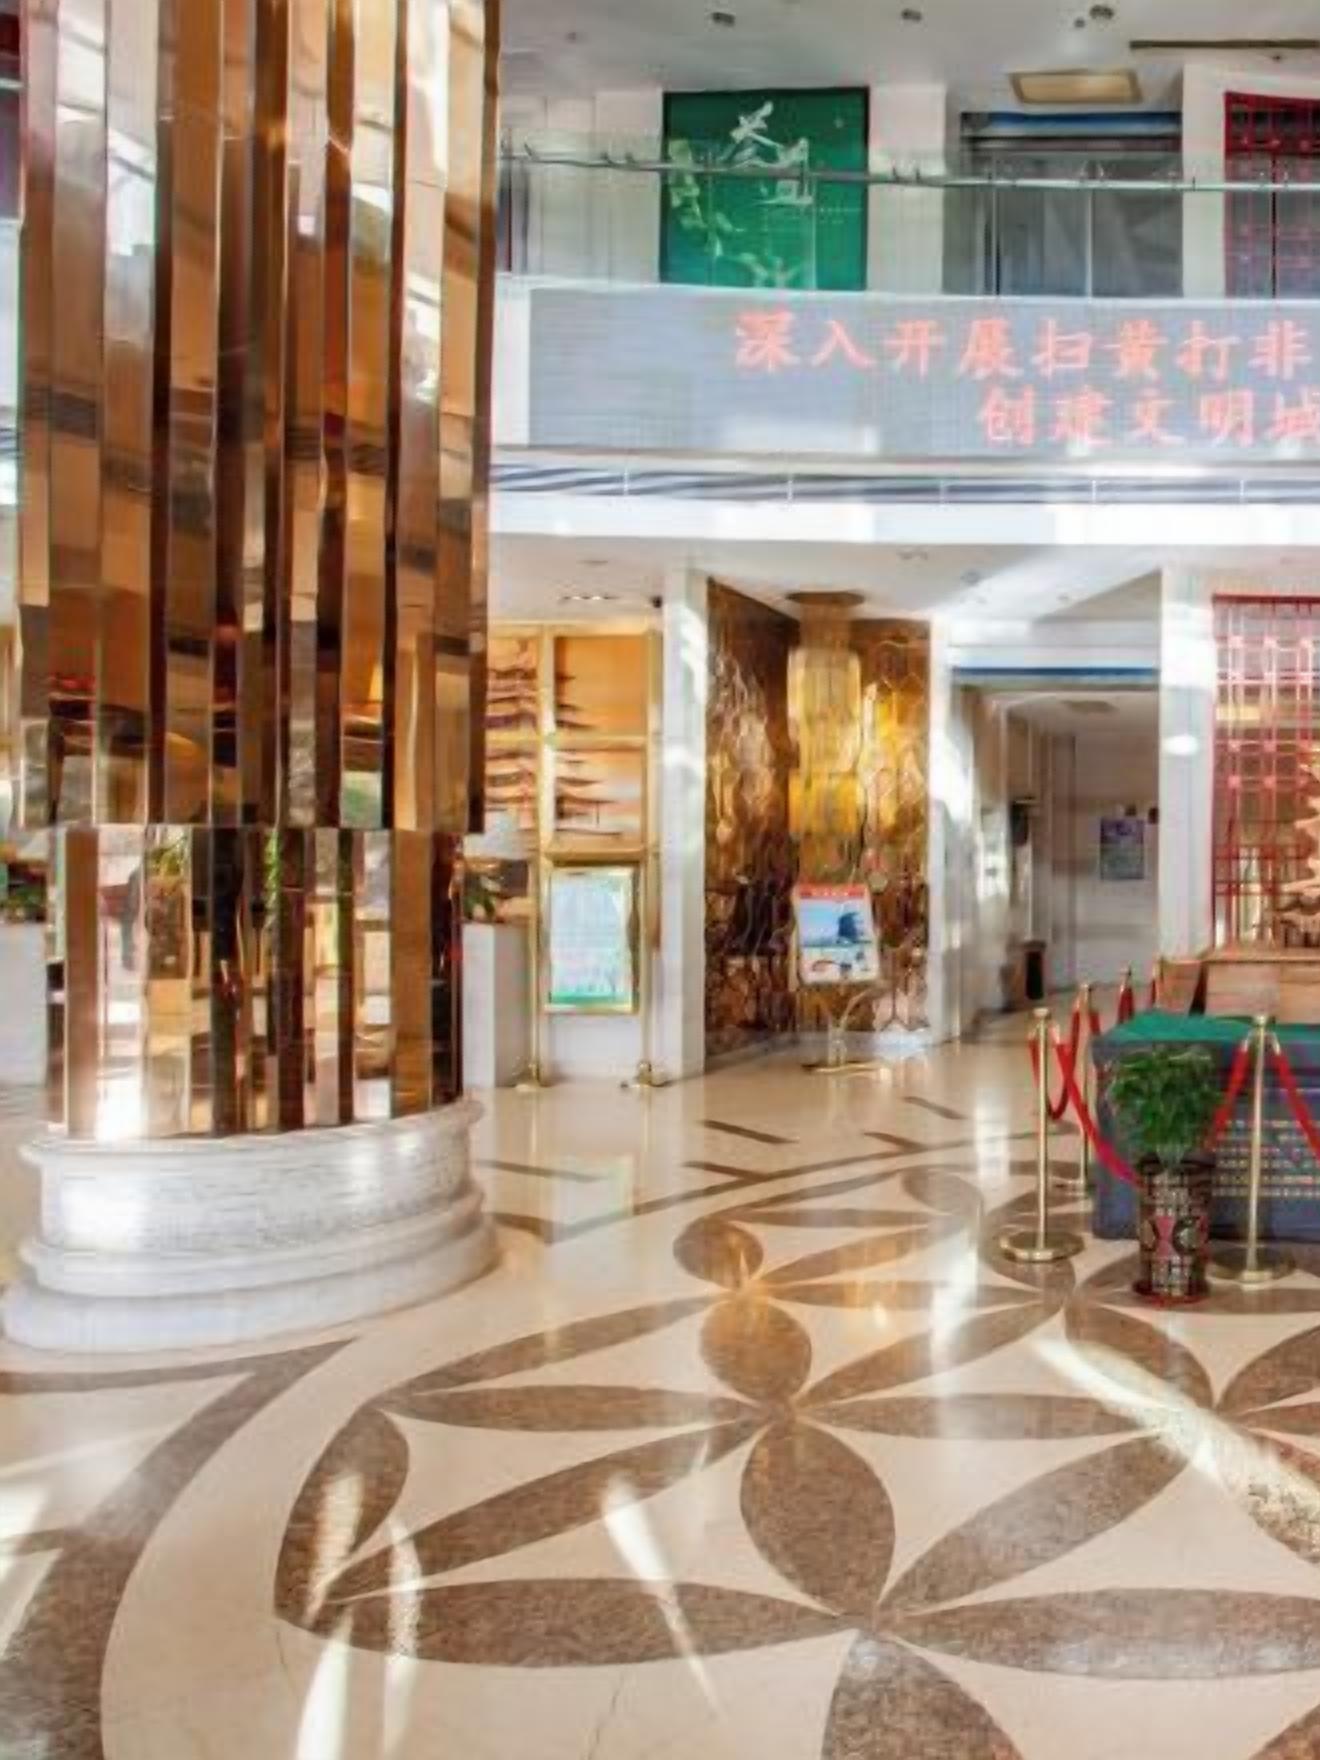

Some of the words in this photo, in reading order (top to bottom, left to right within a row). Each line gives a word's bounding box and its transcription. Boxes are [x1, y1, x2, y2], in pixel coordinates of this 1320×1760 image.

[735, 310, 1311, 375] 深入开展扫黄打非
